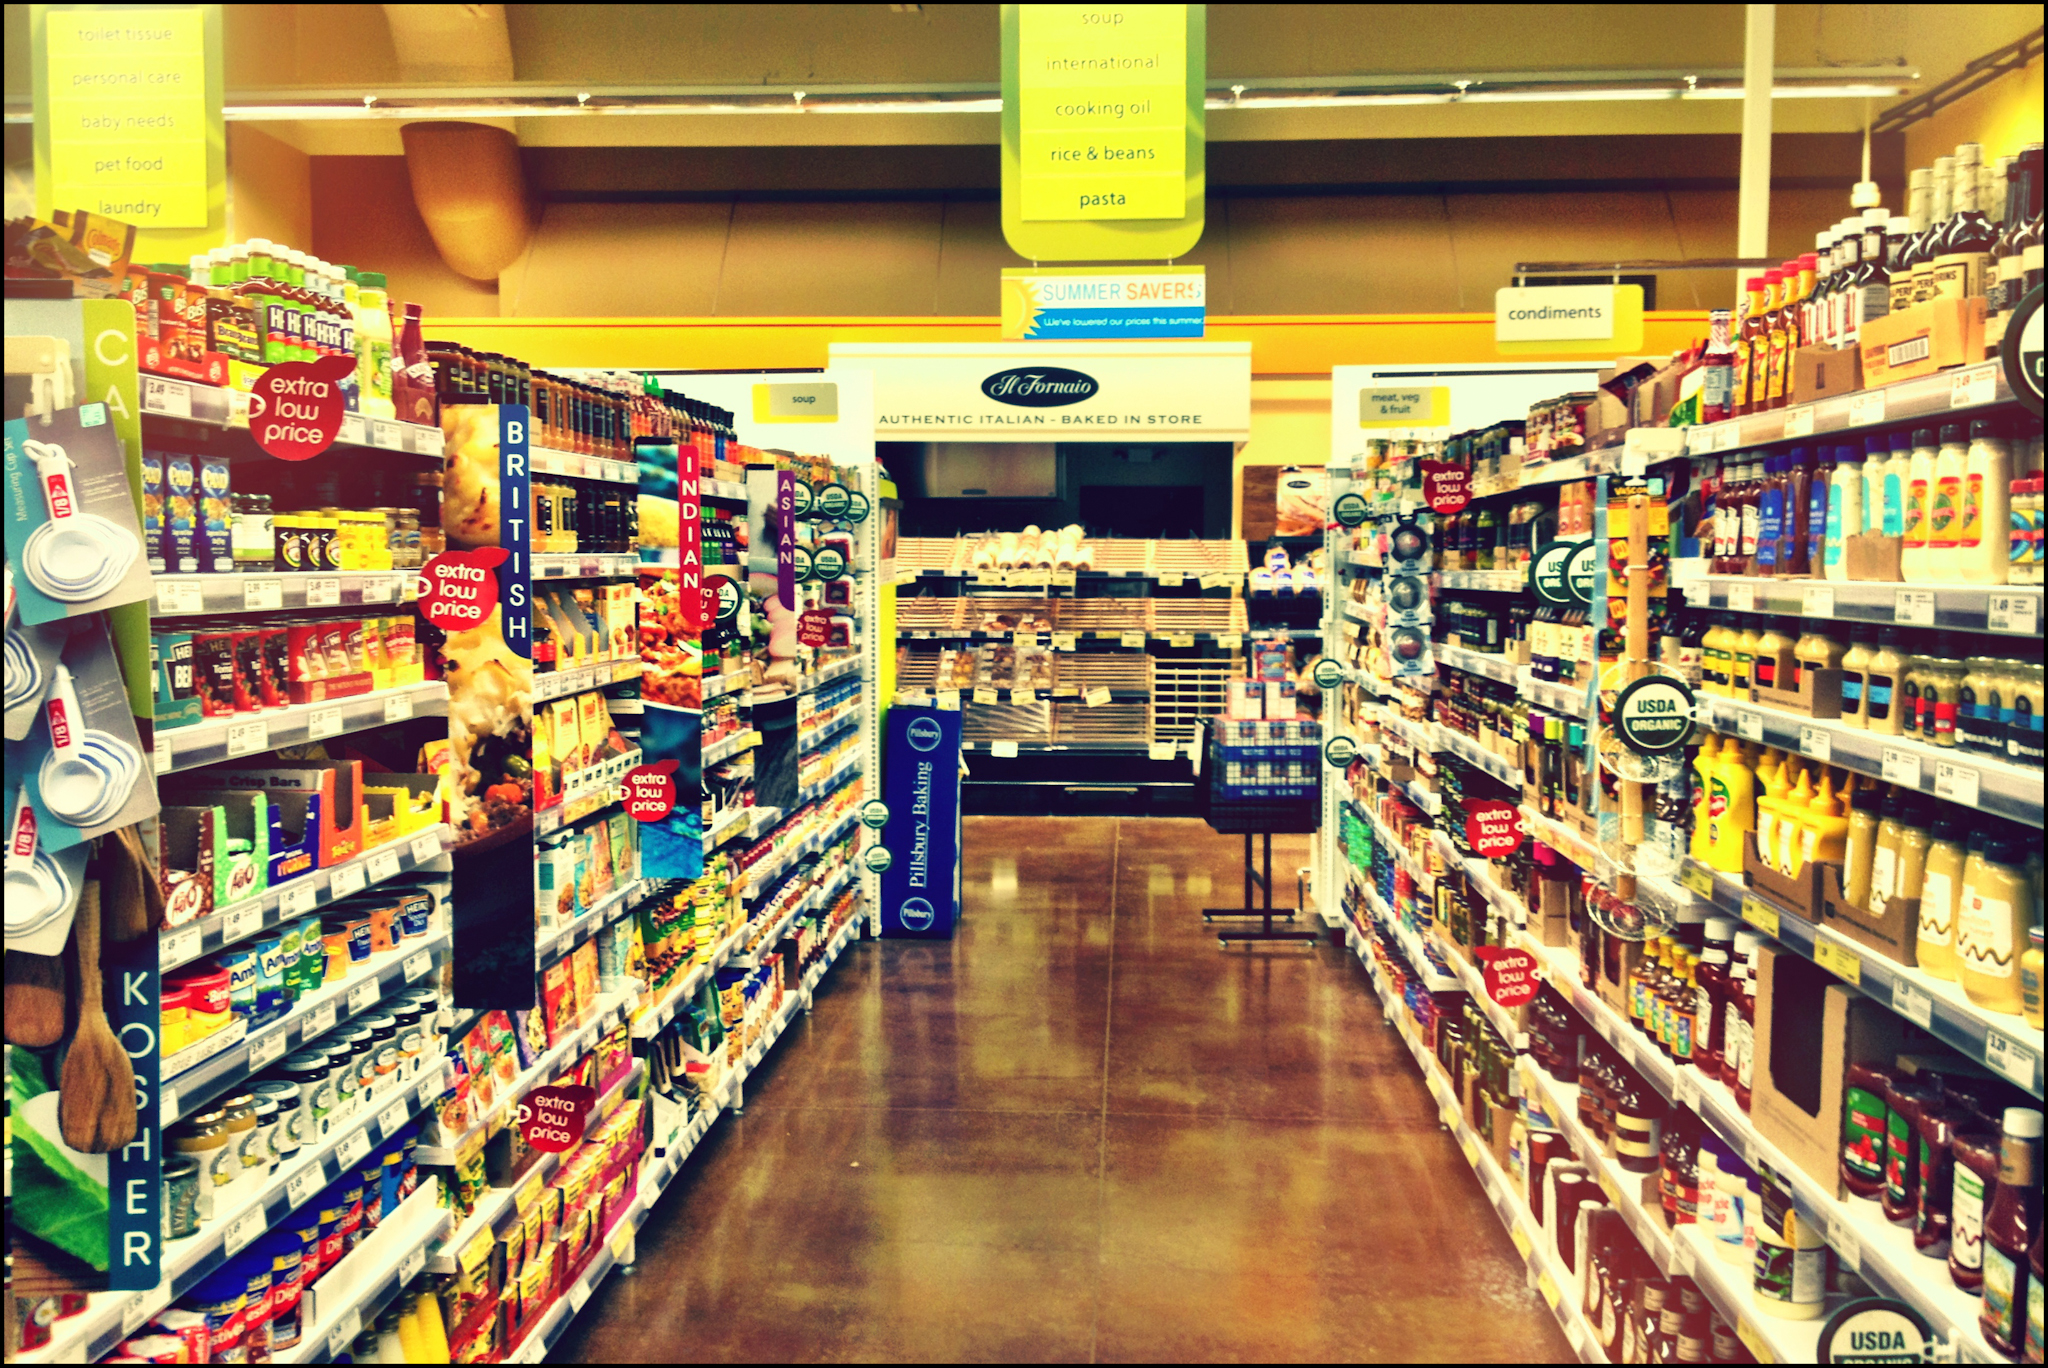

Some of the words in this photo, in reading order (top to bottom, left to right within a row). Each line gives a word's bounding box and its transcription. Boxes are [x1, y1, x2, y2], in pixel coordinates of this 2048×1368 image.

[1082, 12, 1124, 27] soup
[78, 27, 120, 41] toilet
[124, 27, 172, 41] tissue
[1046, 55, 1160, 71] international
[72, 69, 143, 87] personal
[147, 71, 181, 84] care
[1055, 102, 1124, 119] cooking
[1130, 100, 1151, 115] oil
[81, 112, 122, 133] baby
[127, 113, 175, 129] needs
[1051, 147, 1081, 161] rice
[1087, 147, 1099, 161] &
[1104, 146, 1156, 161] beans
[94, 157, 119, 173] pet
[124, 156, 163, 171] food
[1080, 191, 1127, 209] pasta
[98, 200, 161, 219] laundry
[1043, 284, 1121, 301] SUMMER
[1508, 305, 1602, 321] condiments
[1043, 318, 1071, 327] We've
[1073, 318, 1106, 326] lowered
[1125, 317, 1151, 328] prices
[1153, 317, 1166, 325] this
[270, 377, 329, 399] extra
[990, 375, 1021, 396] Il
[1017, 374, 1092, 396] Fornaio
[792, 395, 816, 406] soup
[1402, 394, 1420, 404] veg
[275, 397, 319, 420] low
[1380, 406, 1388, 414] &
[1389, 405, 1411, 414] fruit
[879, 415, 973, 424] AUTHENTIC
[980, 415, 1045, 424] ITALIAN
[1062, 415, 1118, 424] BAKED
[1125, 415, 1141, 424] IN
[1147, 415, 1203, 424] STORE
[264, 422, 323, 444] price
[7, 453, 18, 471] Cup
[1432, 470, 1464, 482] extra
[1436, 482, 1461, 493] low
[10, 471, 27, 522] Measuring
[1433, 494, 1465, 508] price
[55, 498, 71, 519] 1/8
[507, 420, 526, 638] BRITISH
[682, 457, 698, 588] INDIAN
[780, 479, 792, 564] ASIAN
[435, 561, 485, 583] extra
[1548, 560, 1563, 573] US
[1582, 560, 1595, 573] US
[440, 577, 477, 600] low
[430, 595, 482, 620] price
[1638, 699, 1676, 713] USDA
[53, 721, 68, 747] 1/8
[909, 728, 939, 740] Pillsbury
[1632, 718, 1682, 733] ORGANIC
[229, 776, 265, 788] Crisp
[270, 776, 301, 787] Bars
[632, 773, 667, 785] extra
[635, 786, 662, 799] low
[912, 761, 933, 816] Baking
[631, 799, 667, 814] price
[1476, 809, 1512, 822] extra
[1481, 821, 1509, 835] low
[18, 831, 32, 856] 1/8
[1478, 835, 1515, 851] price
[909, 821, 931, 889] Pillsbury
[903, 907, 931, 919] Pillsbury
[1493, 956, 1528, 971] extra
[1498, 970, 1525, 985] low
[1495, 984, 1531, 1001] price
[535, 1095, 576, 1112] extra
[122, 971, 155, 1267] KOSHER
[538, 1108, 568, 1127] low
[529, 1125, 572, 1143] price
[1851, 1331, 1906, 1350] USDA
